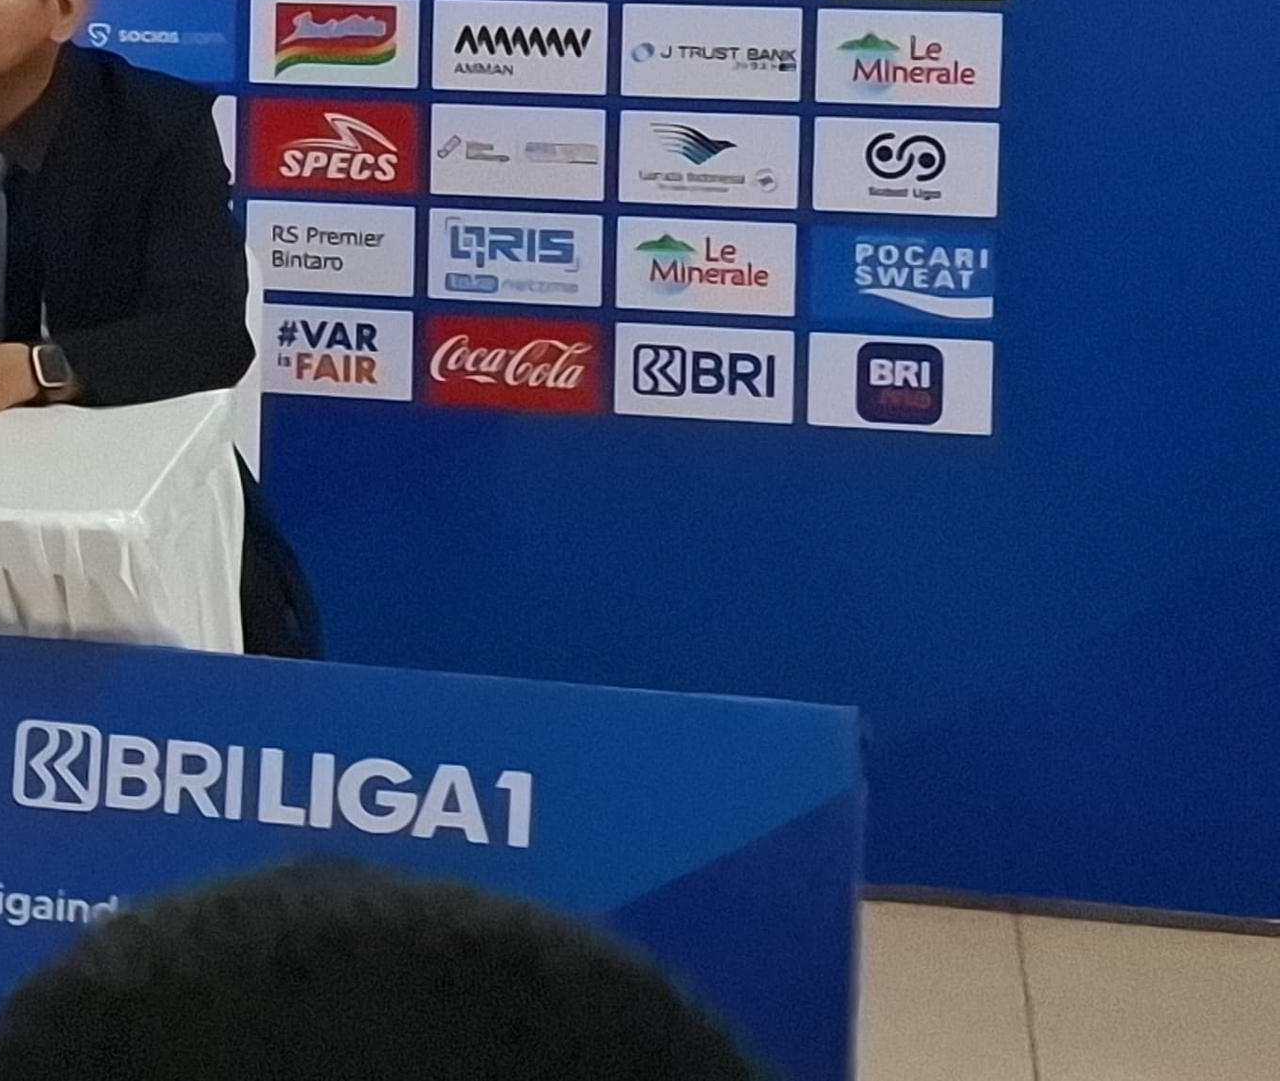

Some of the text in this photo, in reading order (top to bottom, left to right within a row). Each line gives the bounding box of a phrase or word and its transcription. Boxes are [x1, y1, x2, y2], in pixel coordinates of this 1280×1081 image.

[661, 45, 796, 63] J TRUST BANK
[910, 35, 941, 61] Le
[454, 63, 514, 75] AMMAN
[853, 62, 976, 85] Minerale
[280, 150, 398, 181] SPECS
[272, 225, 384, 248] RS Premier
[450, 226, 573, 268] QRIS
[706, 237, 735, 262] Le
[272, 251, 343, 271] Bintaro
[855, 244, 988, 268] POCARI
[649, 259, 769, 287] Minerale
[855, 266, 974, 290] SWEAT
[278, 320, 378, 352] #VAR
[278, 353, 377, 384] is FAIR
[691, 351, 775, 398] BRI
[869, 359, 930, 388] BRI
[106, 735, 532, 848] BRI LIGA 1
